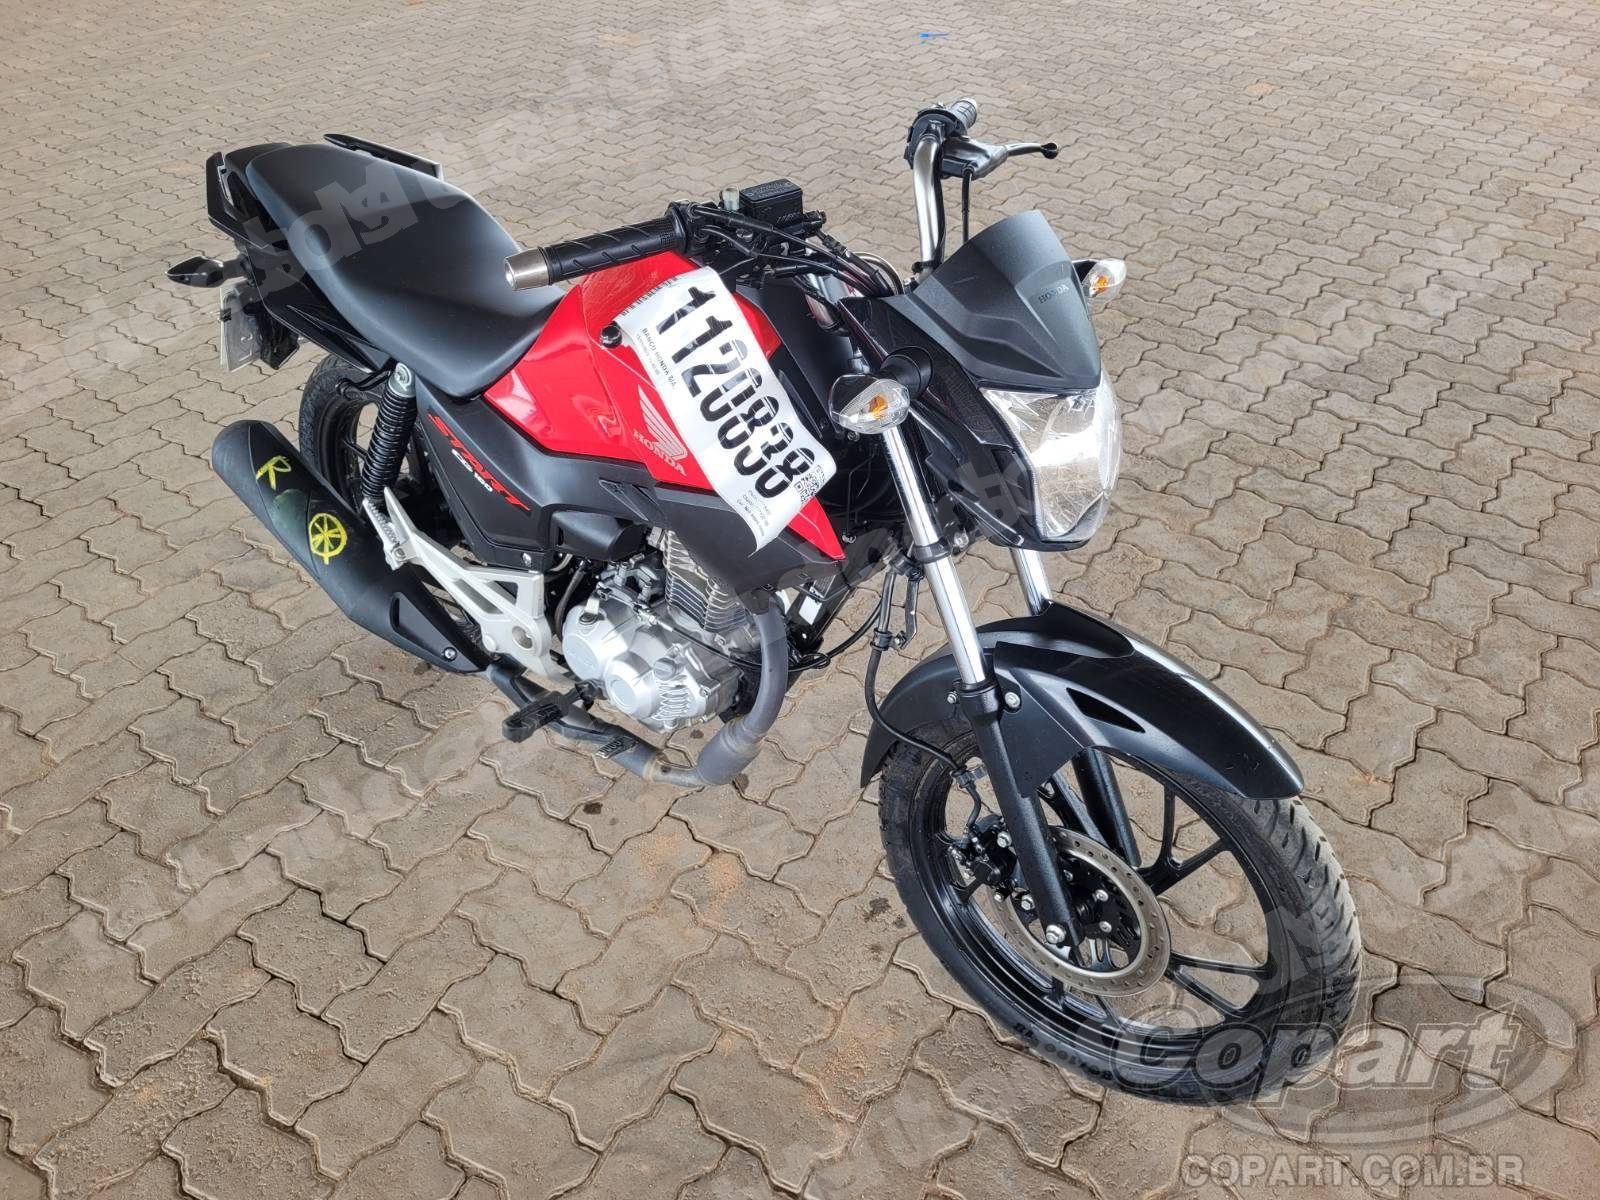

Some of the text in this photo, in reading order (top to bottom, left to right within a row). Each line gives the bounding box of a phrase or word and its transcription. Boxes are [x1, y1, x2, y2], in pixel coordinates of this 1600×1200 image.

[1037, 284, 1070, 304] HONDA
[641, 327, 657, 352] BANCO
[654, 351, 670, 376] HONDA
[656, 286, 815, 499] 1120838
[632, 428, 688, 477] HONDA
